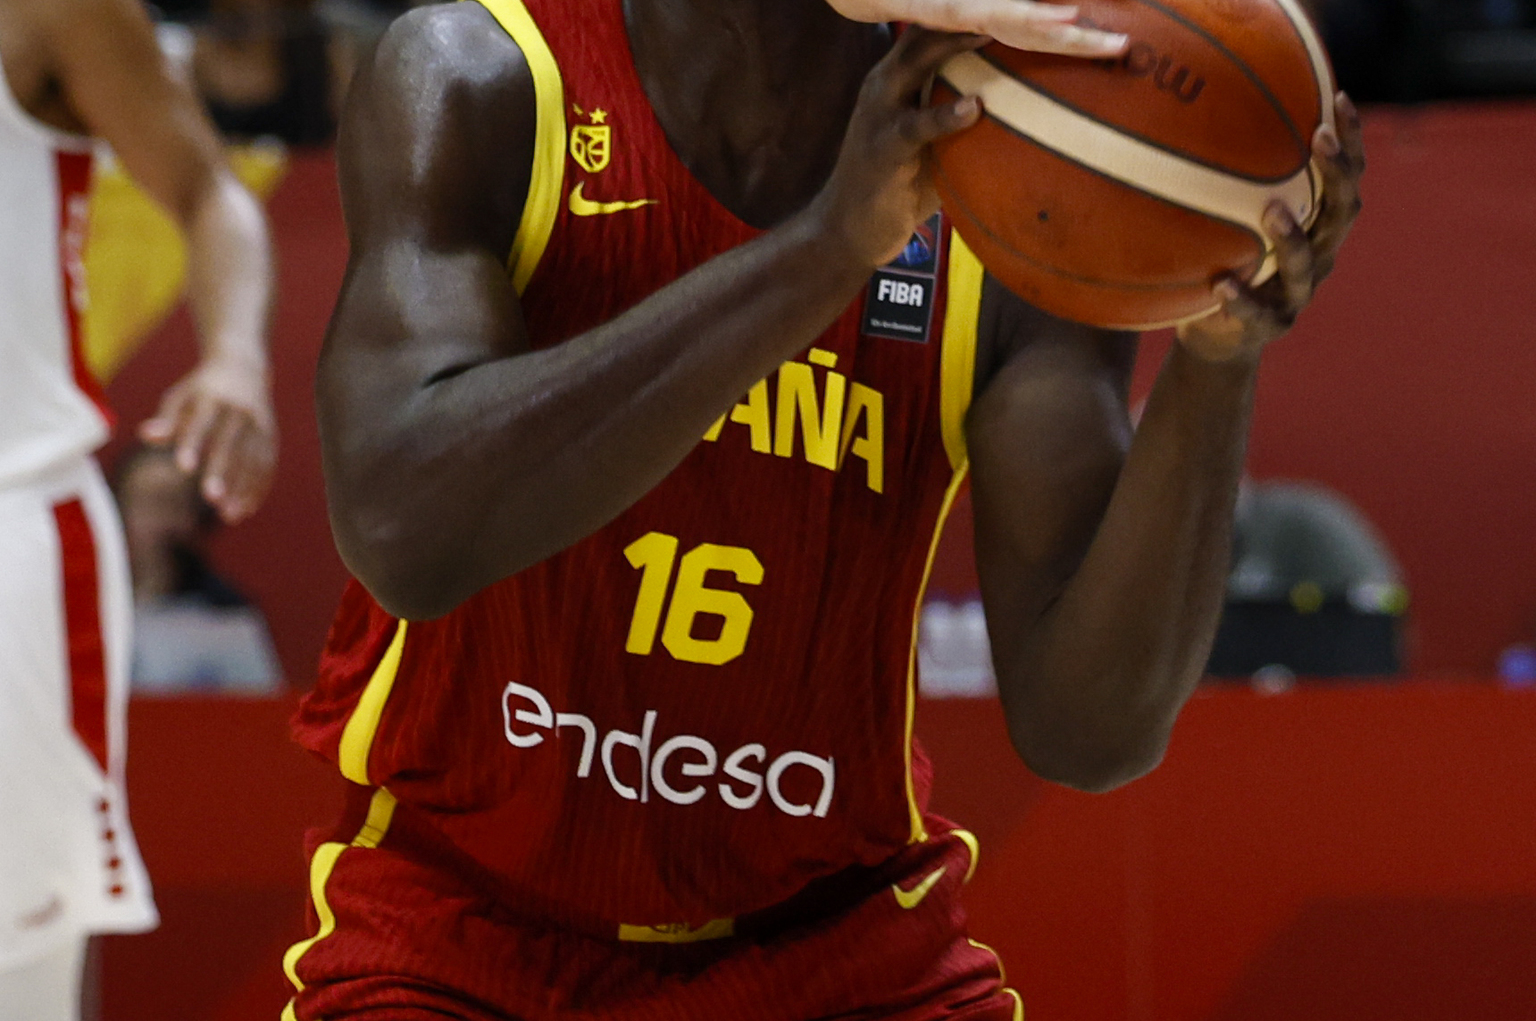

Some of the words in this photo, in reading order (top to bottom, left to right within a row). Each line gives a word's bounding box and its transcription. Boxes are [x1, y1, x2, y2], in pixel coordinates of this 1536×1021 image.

[877, 279, 924, 307] FIBA
[702, 347, 884, 494] AÑA
[623, 531, 764, 665] 16
[501, 681, 835, 818] endesa
